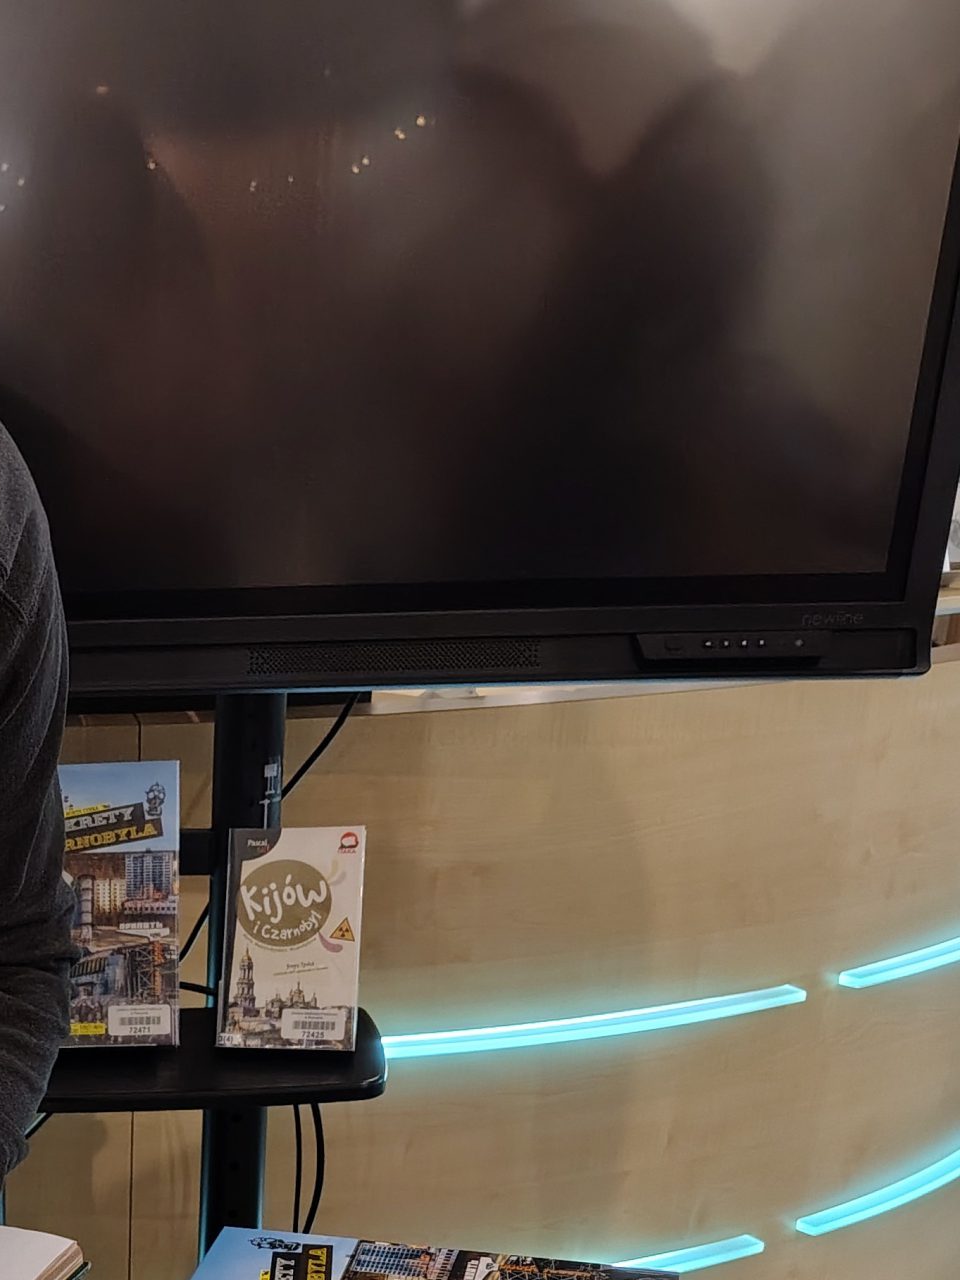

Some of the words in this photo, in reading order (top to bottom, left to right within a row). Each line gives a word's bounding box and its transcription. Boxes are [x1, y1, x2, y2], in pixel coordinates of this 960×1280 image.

[65, 806, 135, 832] KRETY
[64, 823, 158, 852] RNOBYLA
[240, 873, 327, 924] Kijów
[253, 920, 260, 934] i
